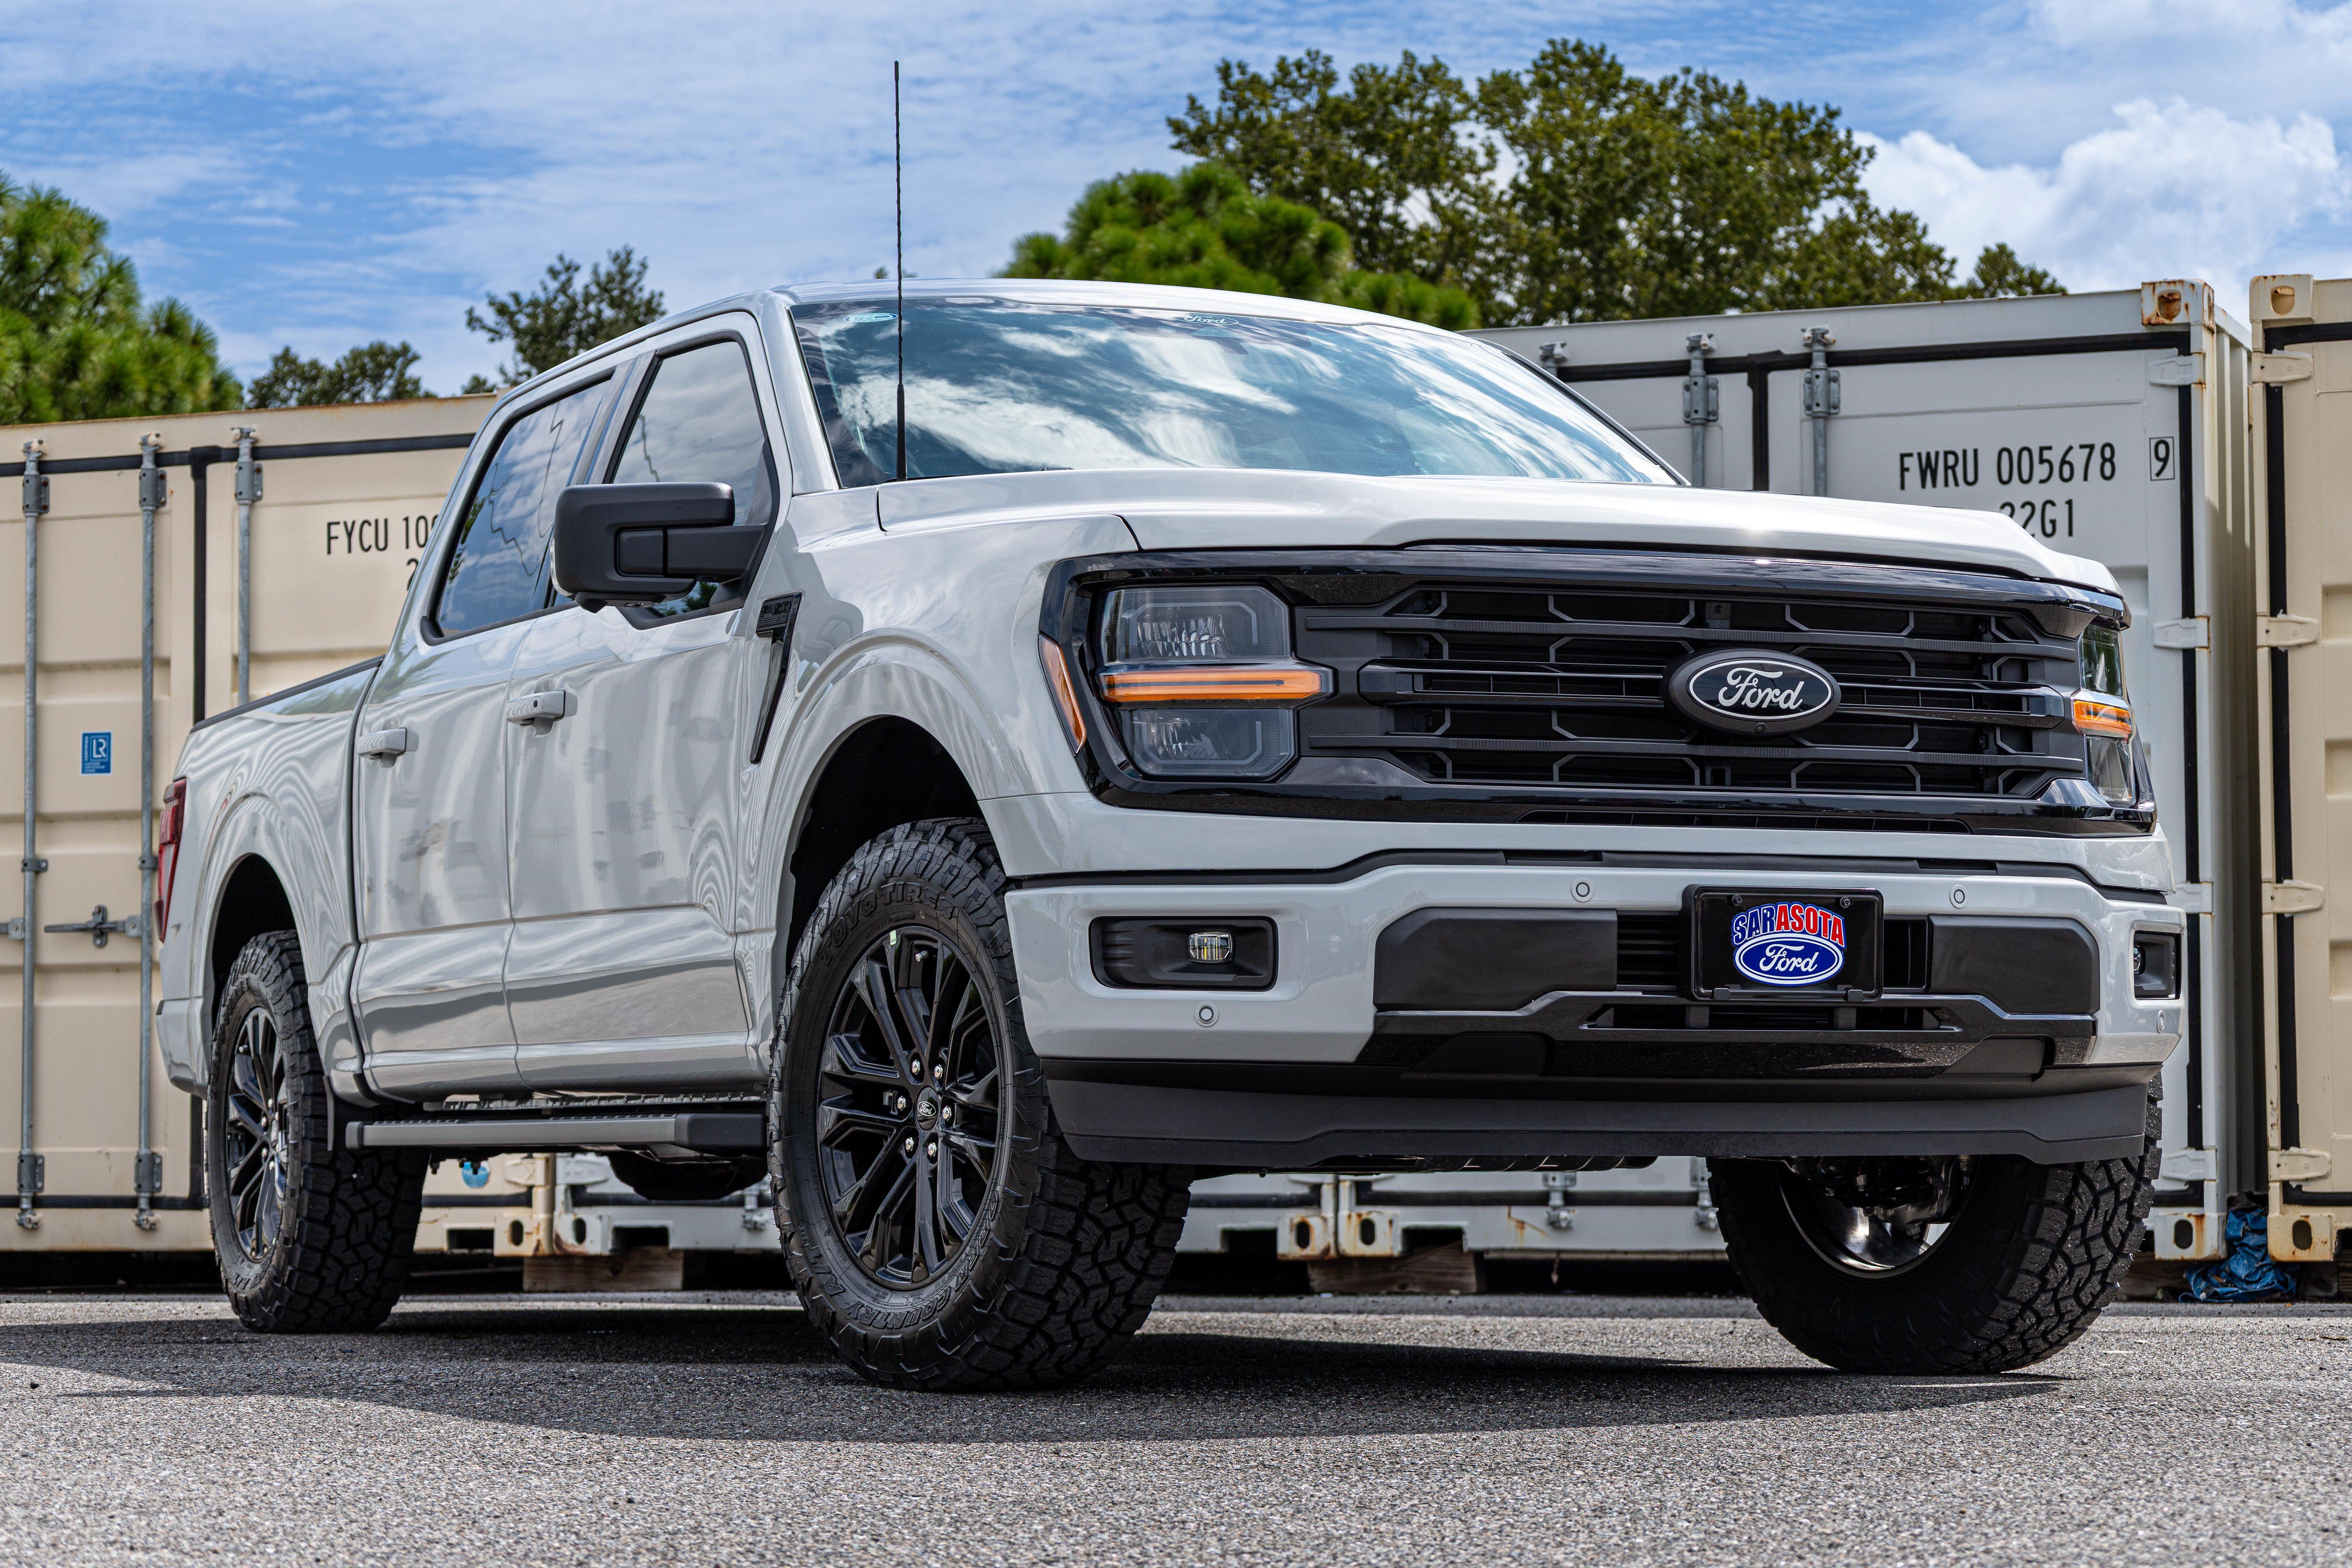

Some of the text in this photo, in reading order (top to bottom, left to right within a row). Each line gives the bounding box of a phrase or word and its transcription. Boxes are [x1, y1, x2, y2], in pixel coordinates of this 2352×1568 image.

[1183, 314, 1227, 324] Ford
[1900, 439, 2170, 490] FWRU 005678 9
[327, 517, 388, 555] FYCU
[761, 600, 792, 617] F-150
[1718, 667, 1805, 710] Ford
[93, 738, 107, 758] LR
[819, 890, 877, 966] TOYO
[881, 882, 955, 919] TIRES
[1733, 904, 1845, 945] SARASOTA
[1759, 944, 1820, 972] Ford
[920, 1102, 933, 1114] Ford
[844, 1285, 952, 1329] COUNTRY
